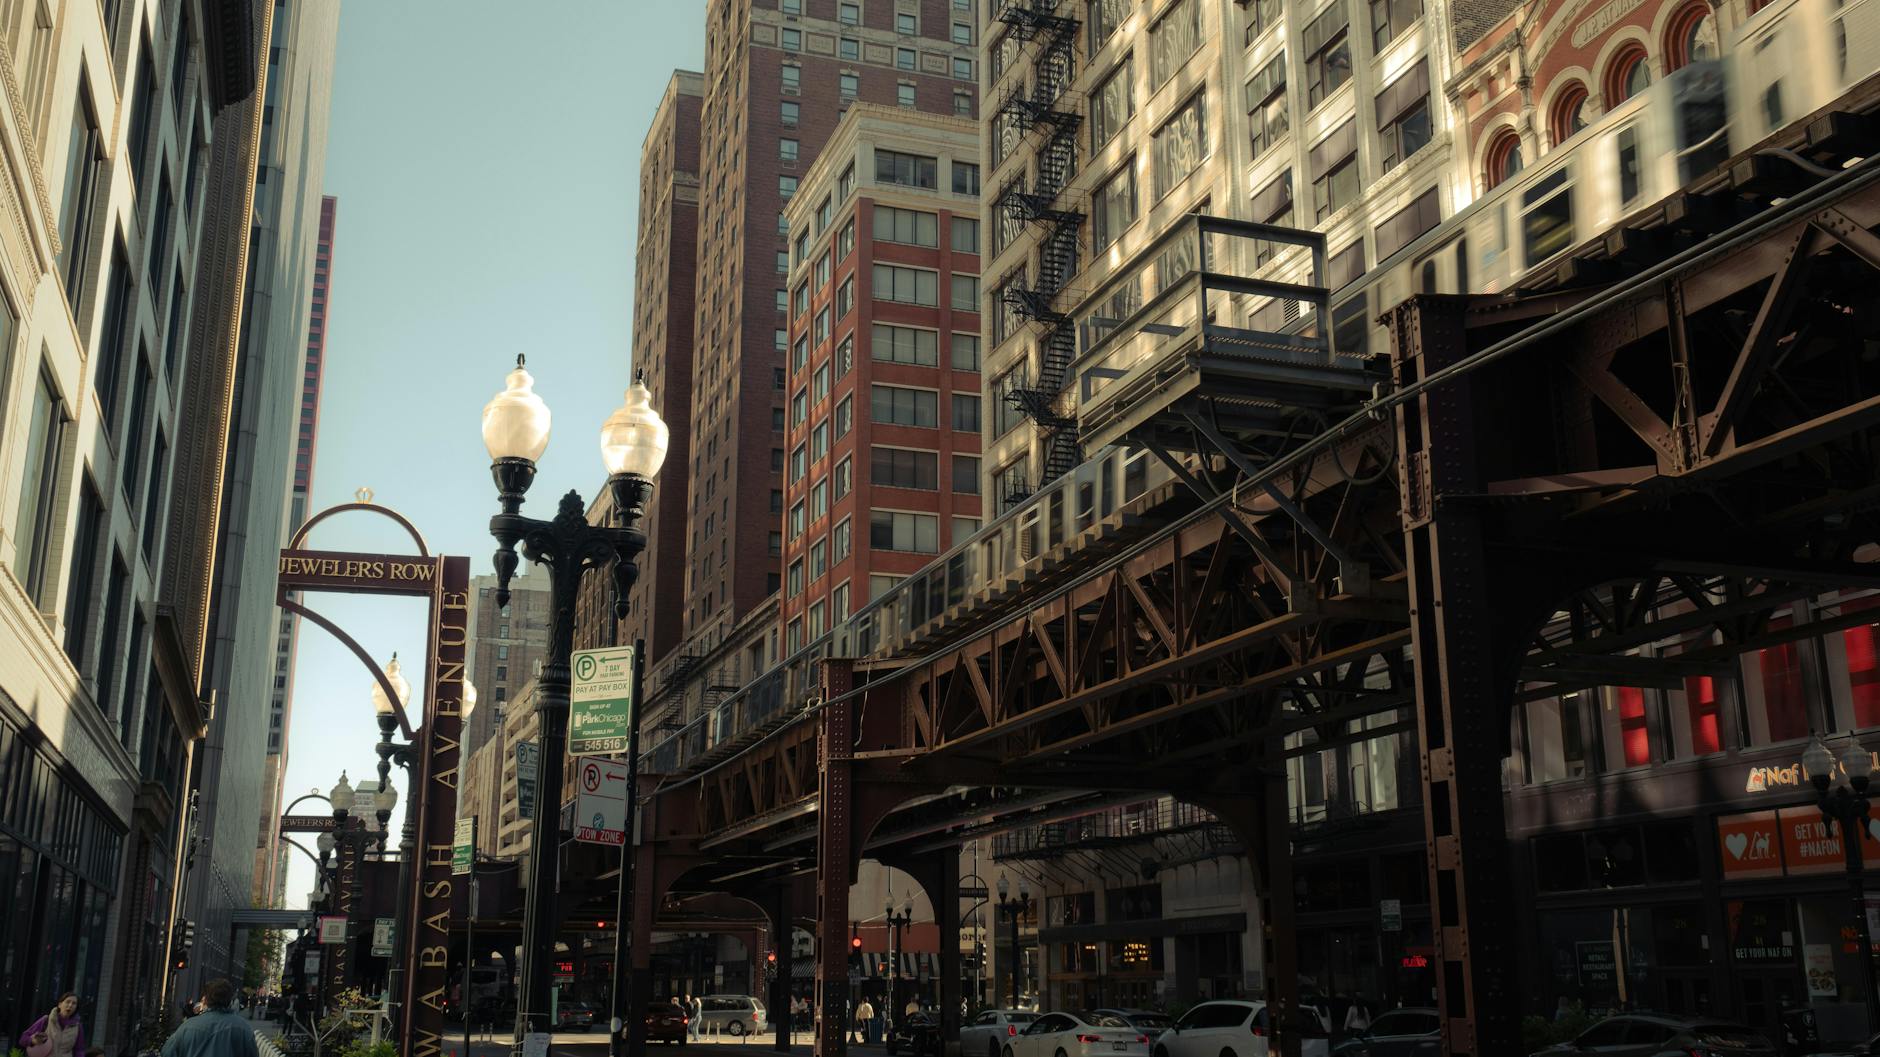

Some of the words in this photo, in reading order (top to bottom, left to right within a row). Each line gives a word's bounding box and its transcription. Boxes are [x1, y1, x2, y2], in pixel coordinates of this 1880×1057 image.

[279, 557, 384, 579] JEWELERS
[390, 562, 437, 582] ROW
[431, 591, 468, 789] AVENUE
[576, 686, 587, 694] PAY
[599, 684, 611, 692] PAY
[613, 682, 628, 690] BOX
[582, 713, 626, 724] ParkChicago
[584, 740, 602, 751] 545
[603, 738, 620, 750] 516
[1766, 763, 1799, 786] Naf
[281, 819, 324, 827] JEWELERS
[324, 819, 337, 827] RO
[1795, 822, 1811, 840] GET
[581, 828, 597, 841] TOW
[600, 831, 621, 843] ZONE
[1799, 839, 1841, 858] #NAFON
[413, 843, 454, 1057] WABASH
[1735, 948, 1747, 959] GET
[1749, 947, 1766, 958] YOUR
[1782, 946, 1793, 957] ON
